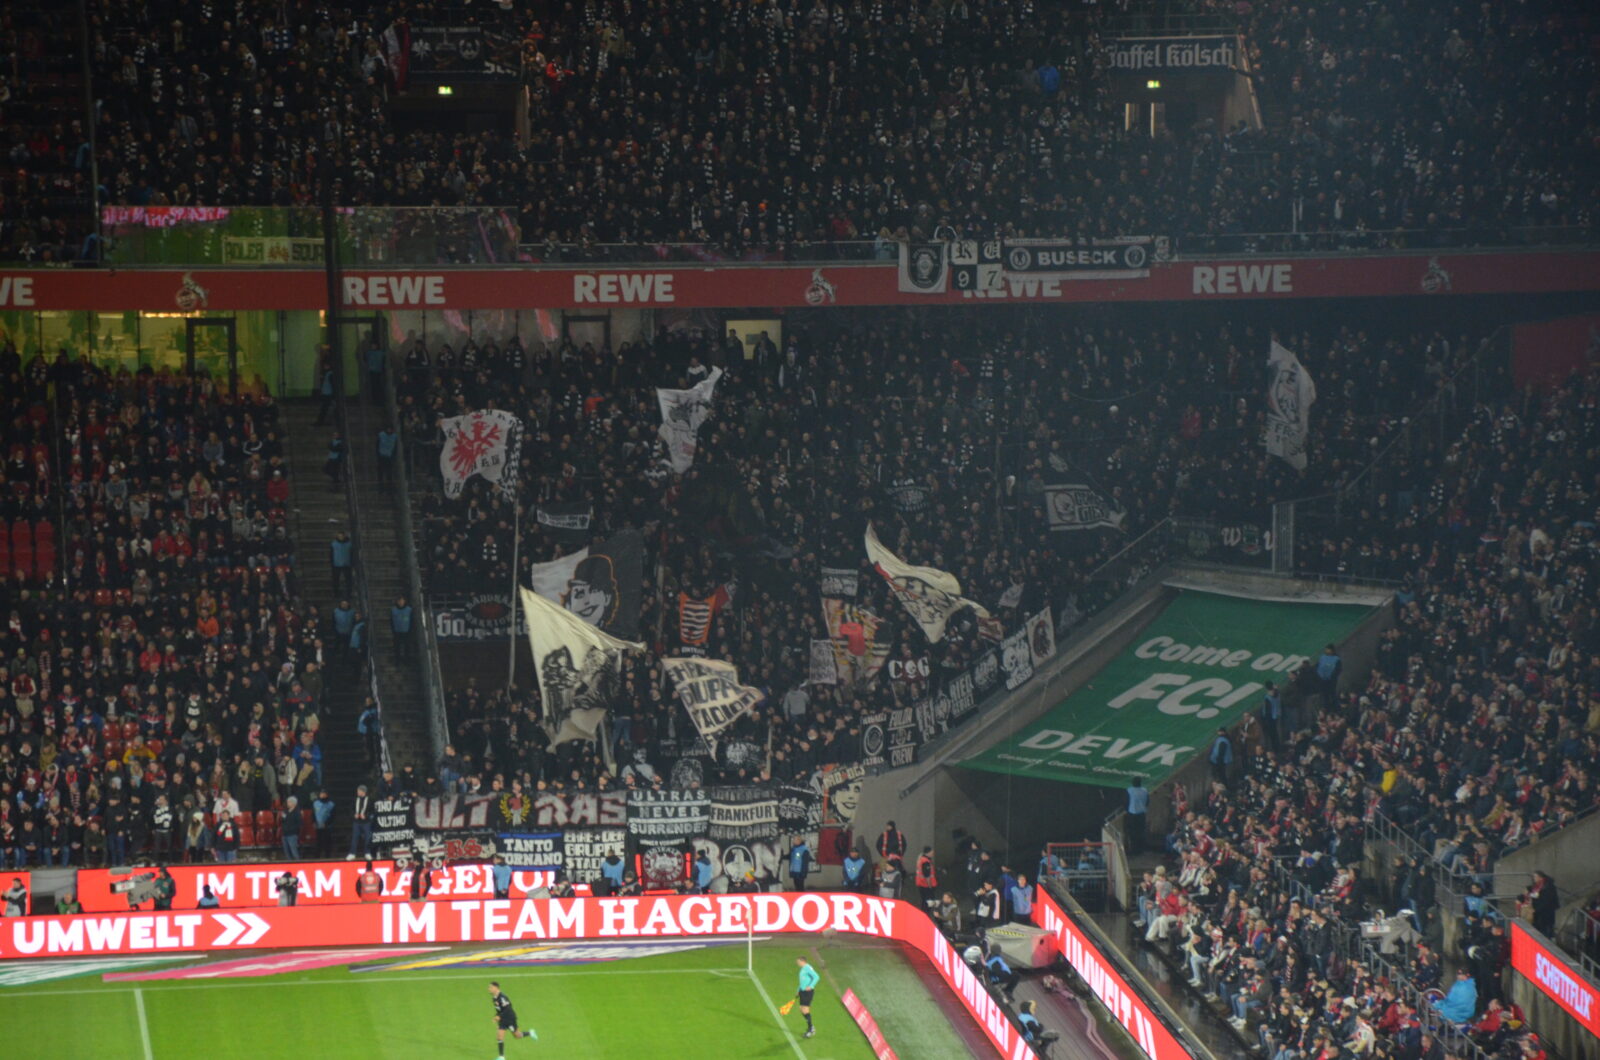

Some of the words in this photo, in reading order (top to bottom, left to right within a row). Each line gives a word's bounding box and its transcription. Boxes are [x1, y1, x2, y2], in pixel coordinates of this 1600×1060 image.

[1167, 42, 1233, 69] Kölsch
[1038, 251, 1116, 266] BUSECK
[341, 276, 447, 305] REWE
[573, 273, 675, 303] REWE
[1192, 264, 1293, 294] REWE
[1134, 635, 1253, 668] Come
[1250, 652, 1311, 673] on
[1107, 673, 1264, 719] FC!
[1018, 729, 1195, 766] DEVK
[633, 789, 705, 801] ULTRAS
[639, 806, 701, 818] NEVER
[711, 804, 779, 821] FRANKFURT
[630, 822, 708, 835] SURRENDER
[503, 839, 554, 852] TANTO
[564, 841, 625, 857] GRUPPE
[196, 872, 235, 901] IM
[245, 869, 341, 899] TEAM
[382, 900, 436, 944] IM
[451, 897, 586, 942] TEAM
[598, 893, 896, 937] HAGEDORN
[13, 914, 202, 954] UMWELT
[1066, 928, 1131, 1031] UMWELT
[953, 951, 1009, 1053] UMWELT
